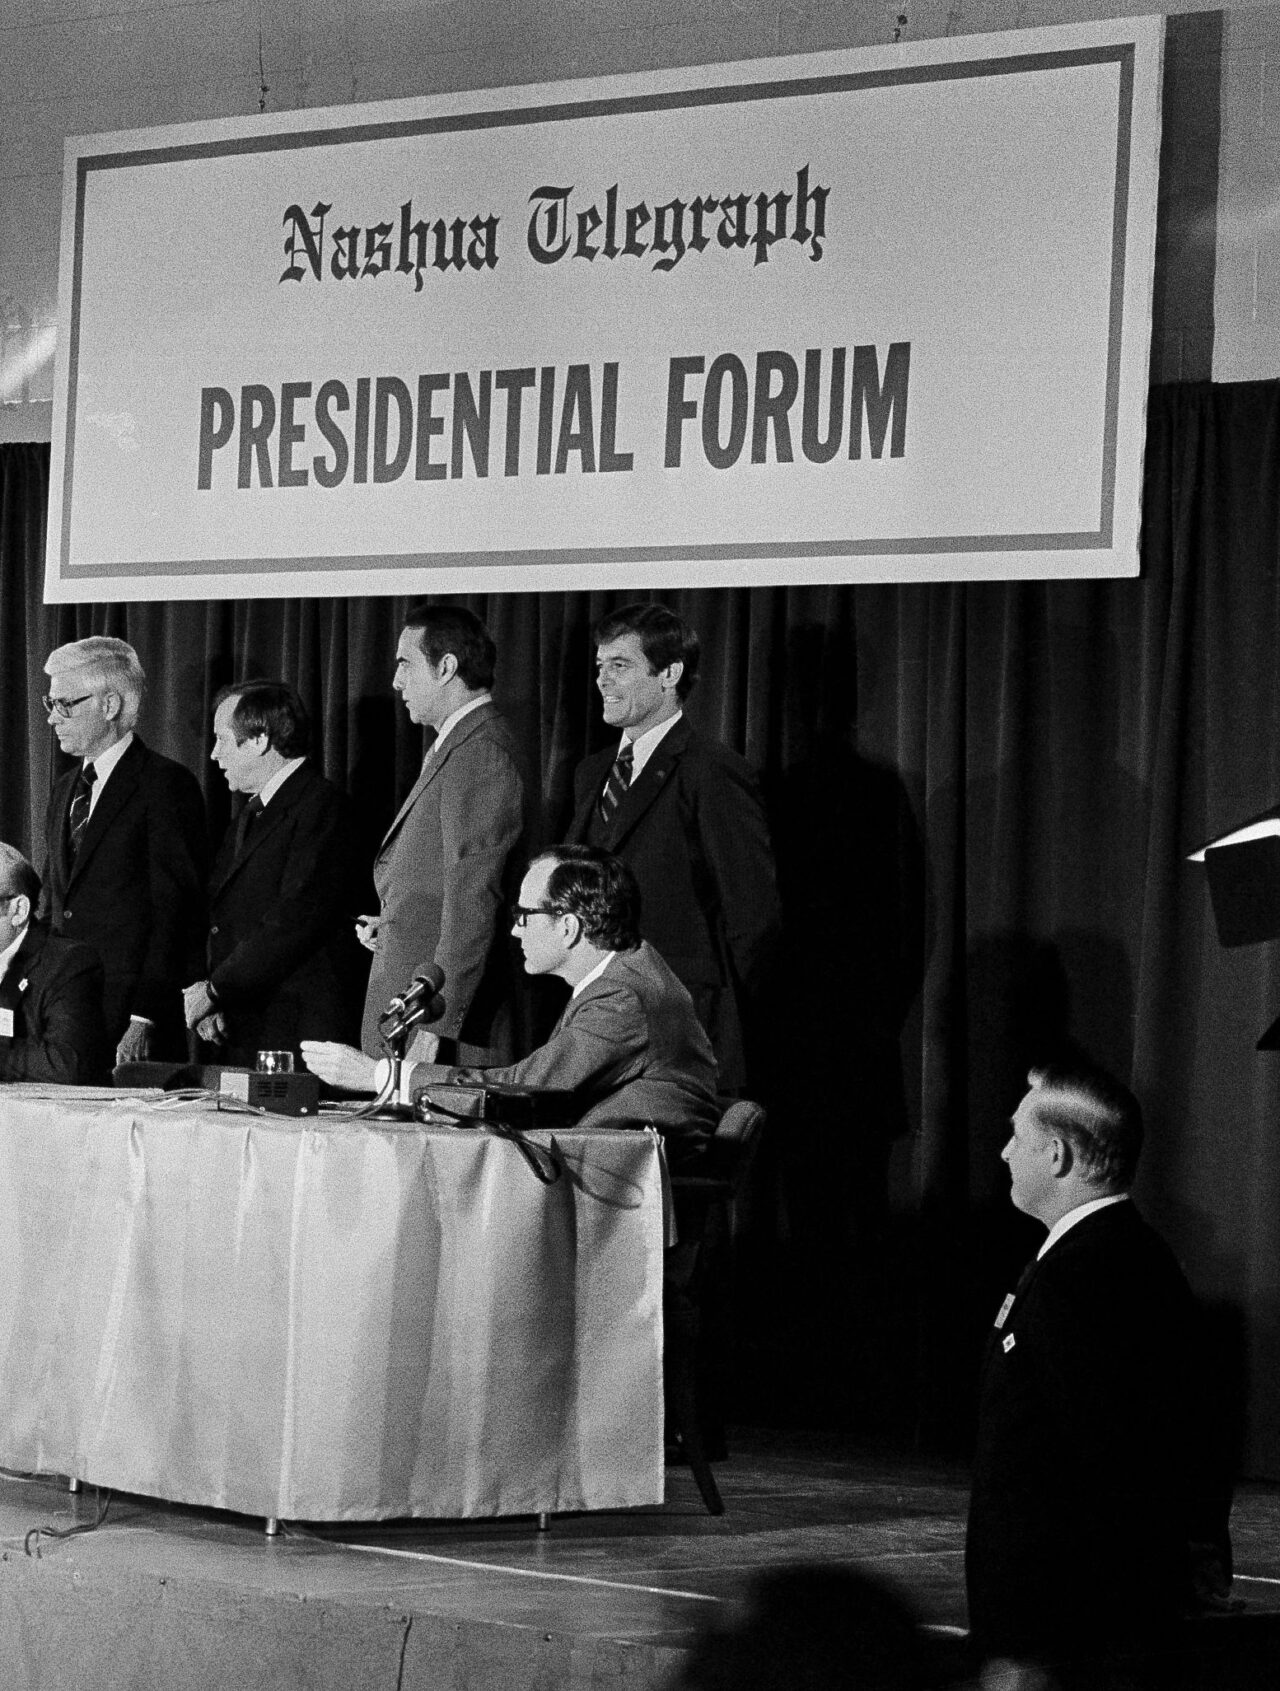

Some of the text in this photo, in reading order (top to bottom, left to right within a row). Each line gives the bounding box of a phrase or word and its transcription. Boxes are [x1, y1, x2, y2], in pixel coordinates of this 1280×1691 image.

[280, 163, 830, 292] Nashua Telegraph
[198, 341, 910, 489] PRESIDENTIAL FORUM
